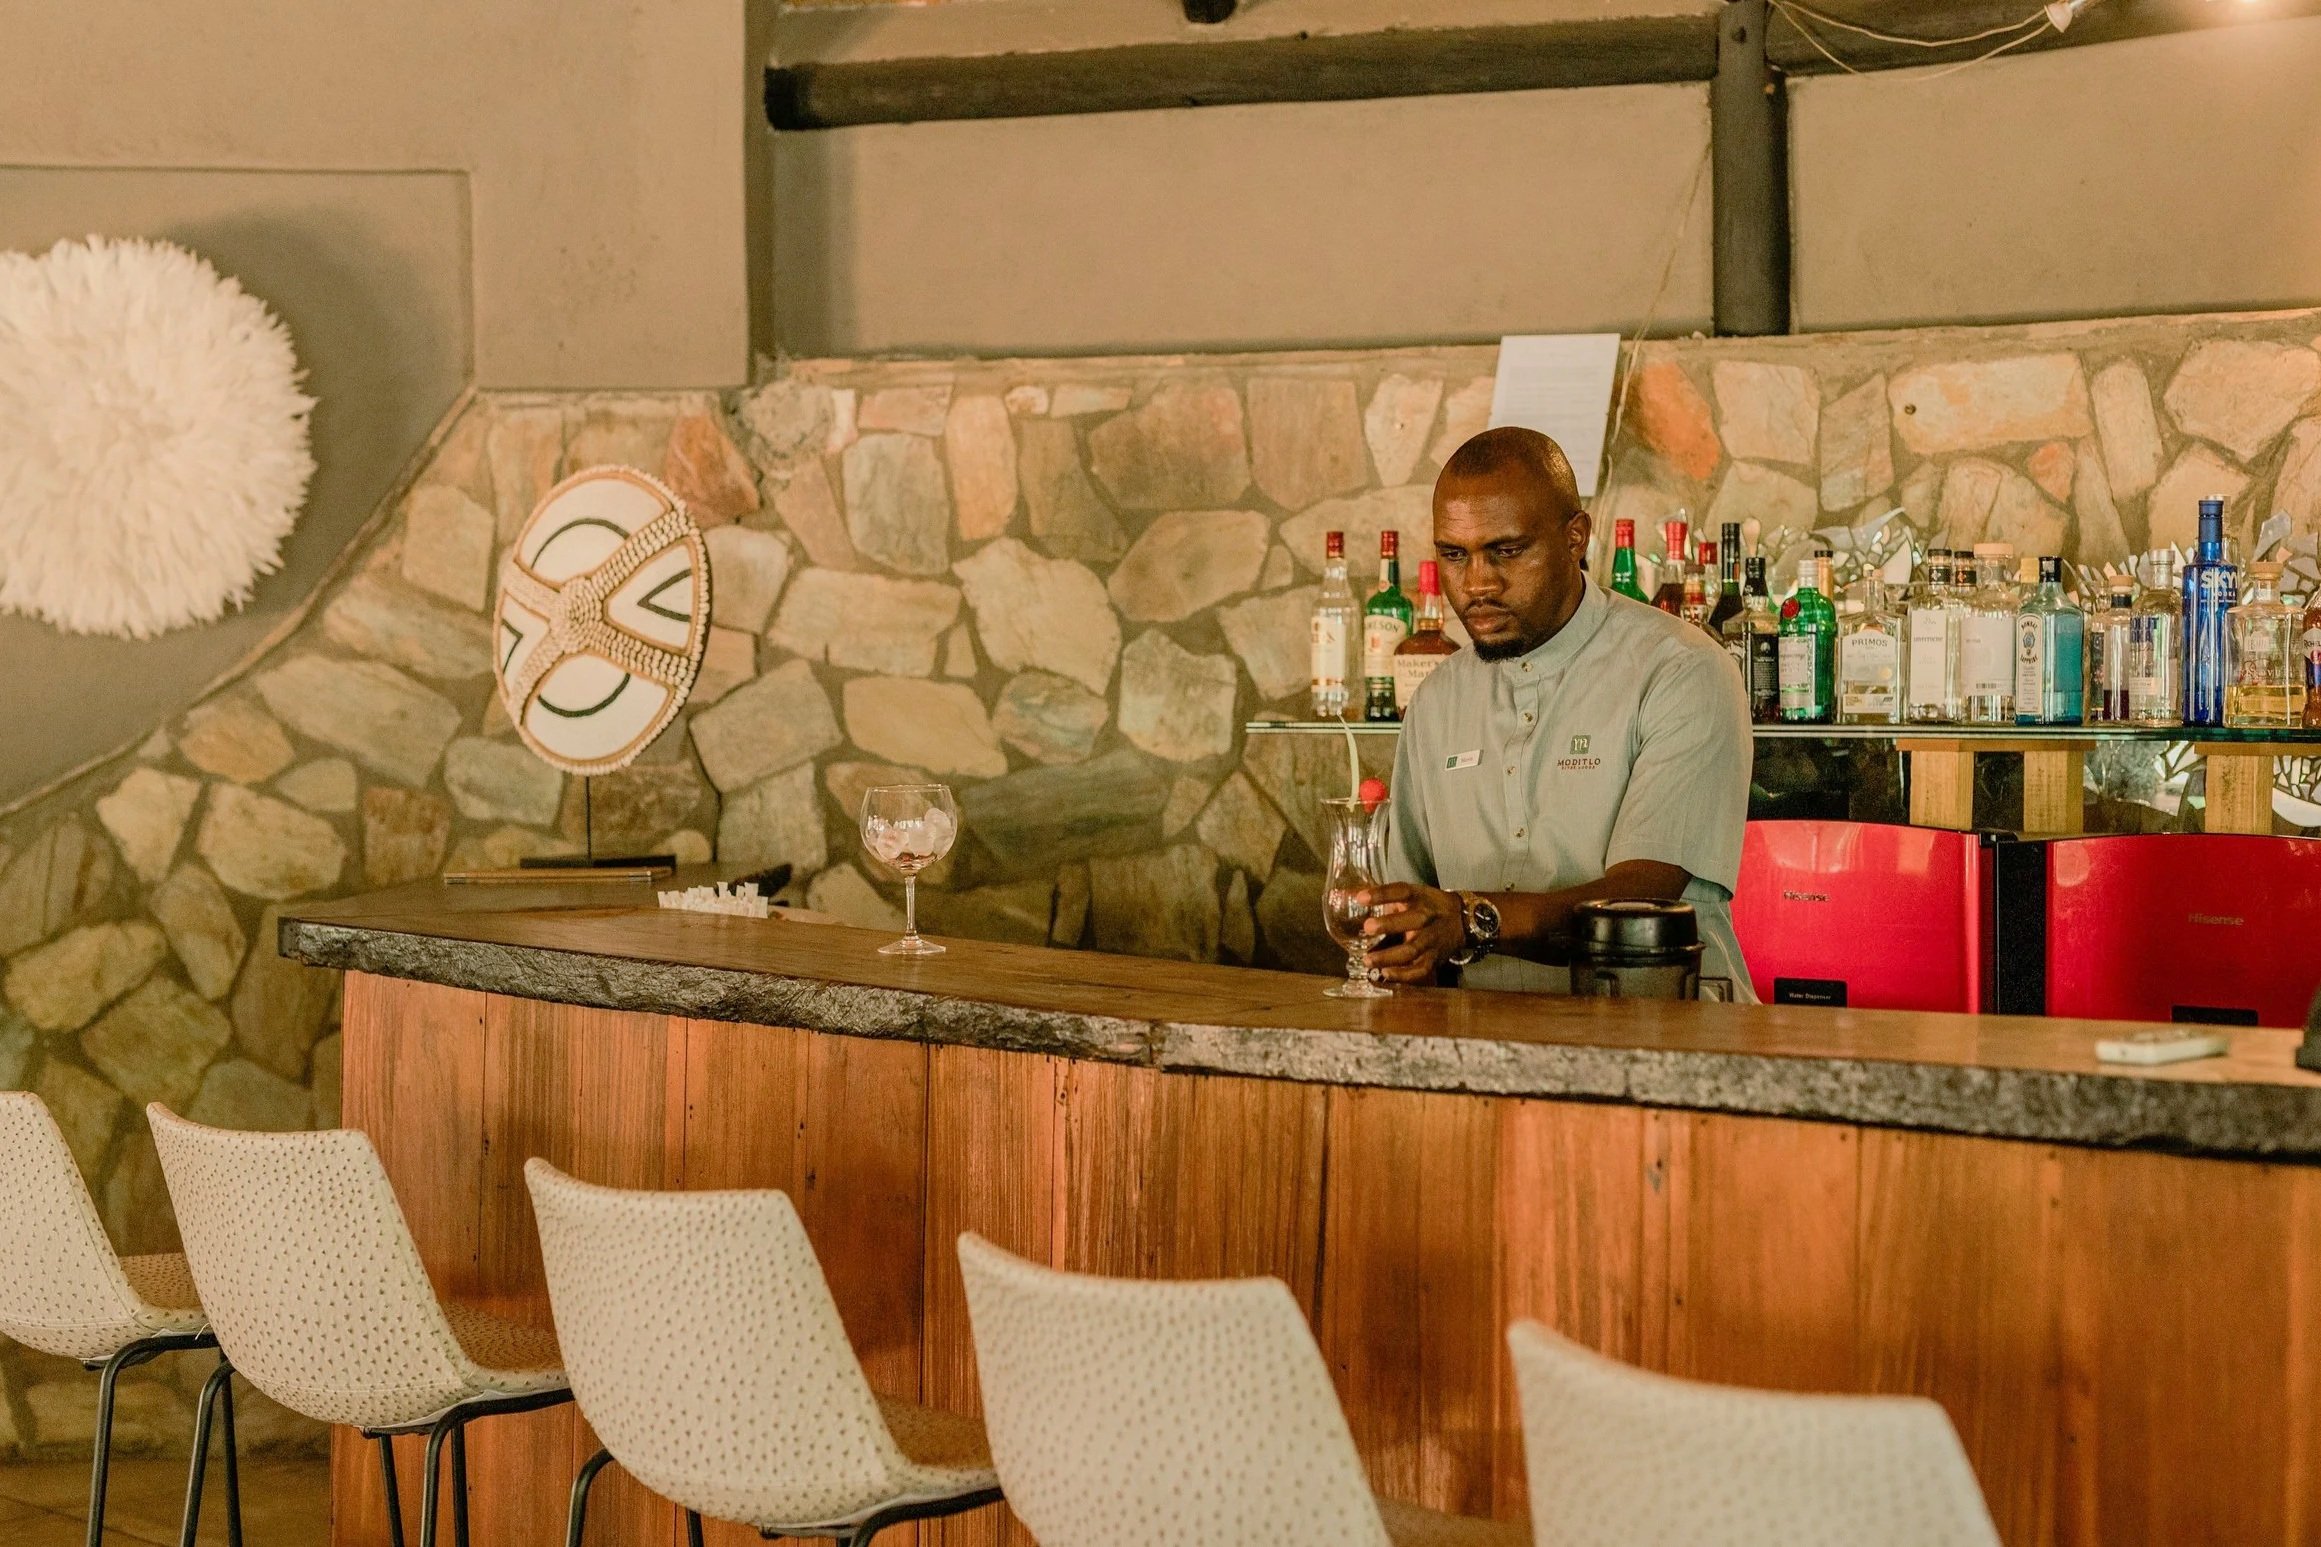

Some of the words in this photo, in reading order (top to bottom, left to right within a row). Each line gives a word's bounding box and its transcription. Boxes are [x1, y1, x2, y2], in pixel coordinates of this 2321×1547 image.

[1851, 638, 1889, 648] PRIMOS
[1408, 668, 1430, 679] Mar
[1557, 758, 1601, 767] MODITLO
[1783, 890, 1830, 903] Hisense
[2187, 912, 2245, 926] Hisense
